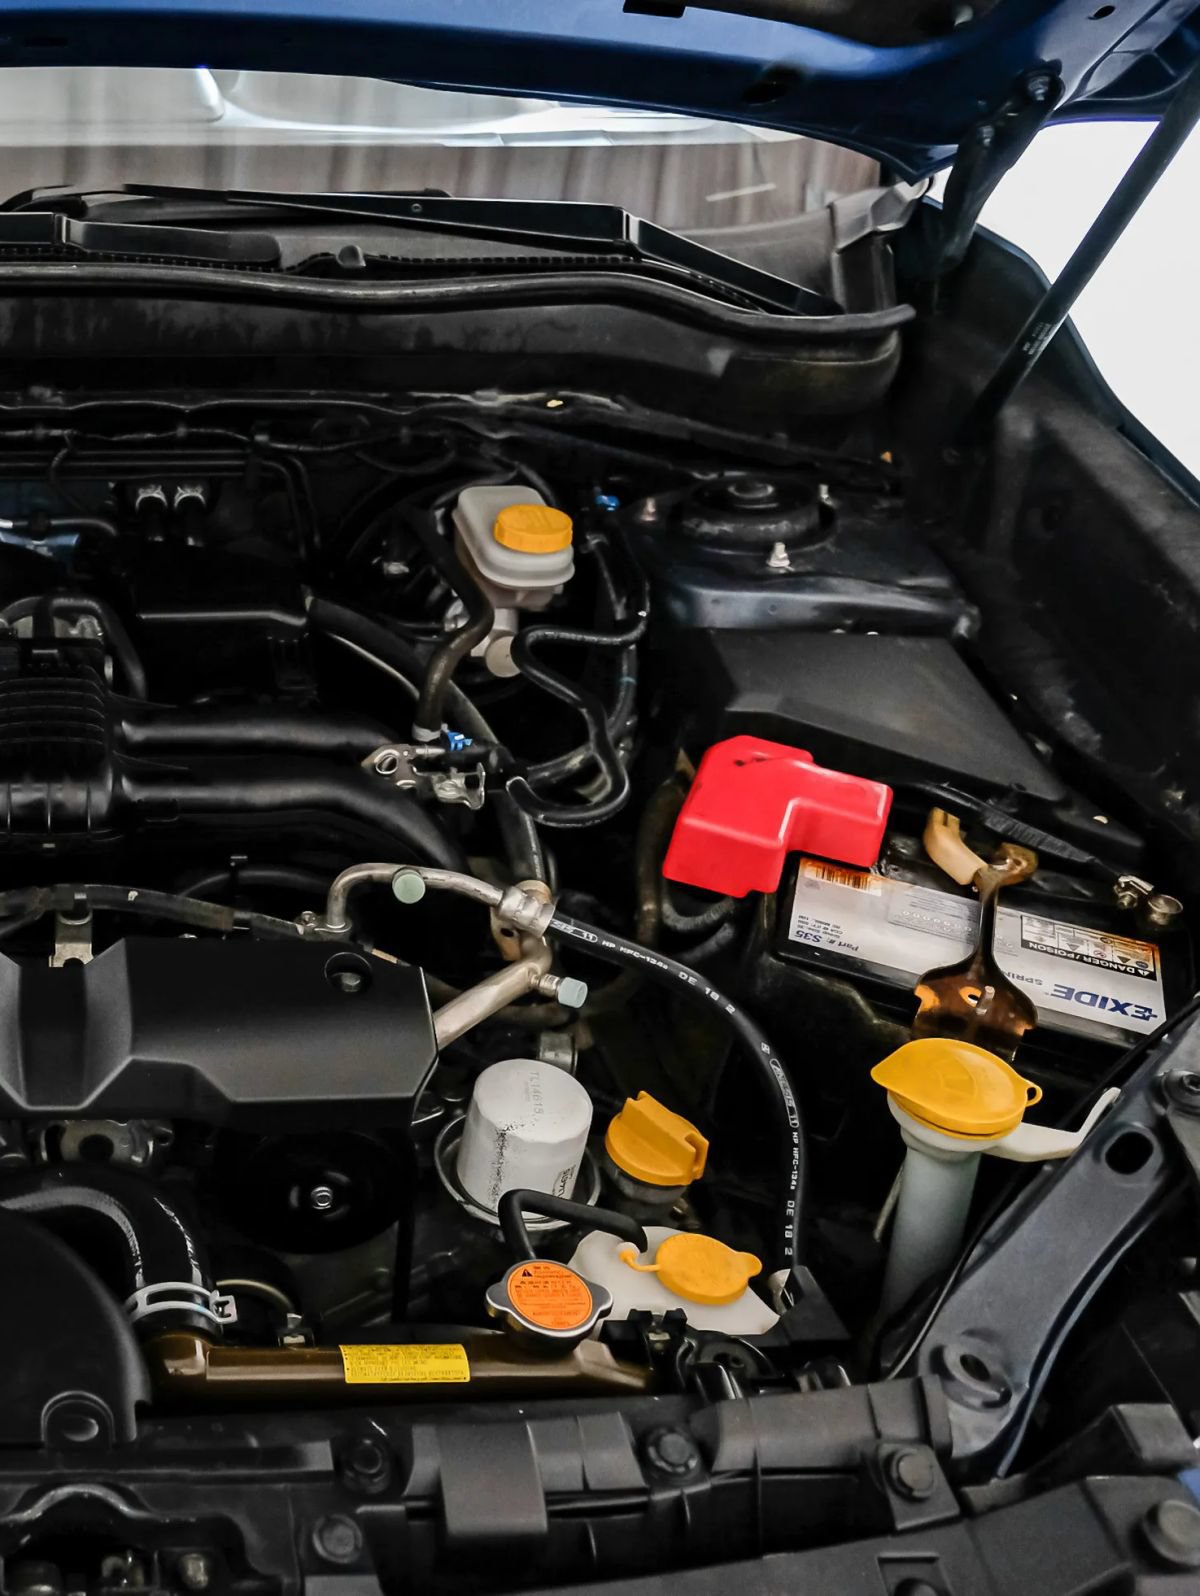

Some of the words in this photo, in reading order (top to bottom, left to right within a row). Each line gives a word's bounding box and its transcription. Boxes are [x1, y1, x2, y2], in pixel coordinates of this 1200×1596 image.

[794, 930, 822, 943] S35
[838, 941, 859, 952] Part
[1029, 942, 1075, 960] POISON
[1083, 956, 1135, 974] DANGER
[678, 971, 697, 986] DE
[725, 1003, 736, 1015] 2
[1051, 984, 1157, 1022] EXIDE
[786, 1200, 795, 1217] DE
[784, 1247, 793, 1256] 2
